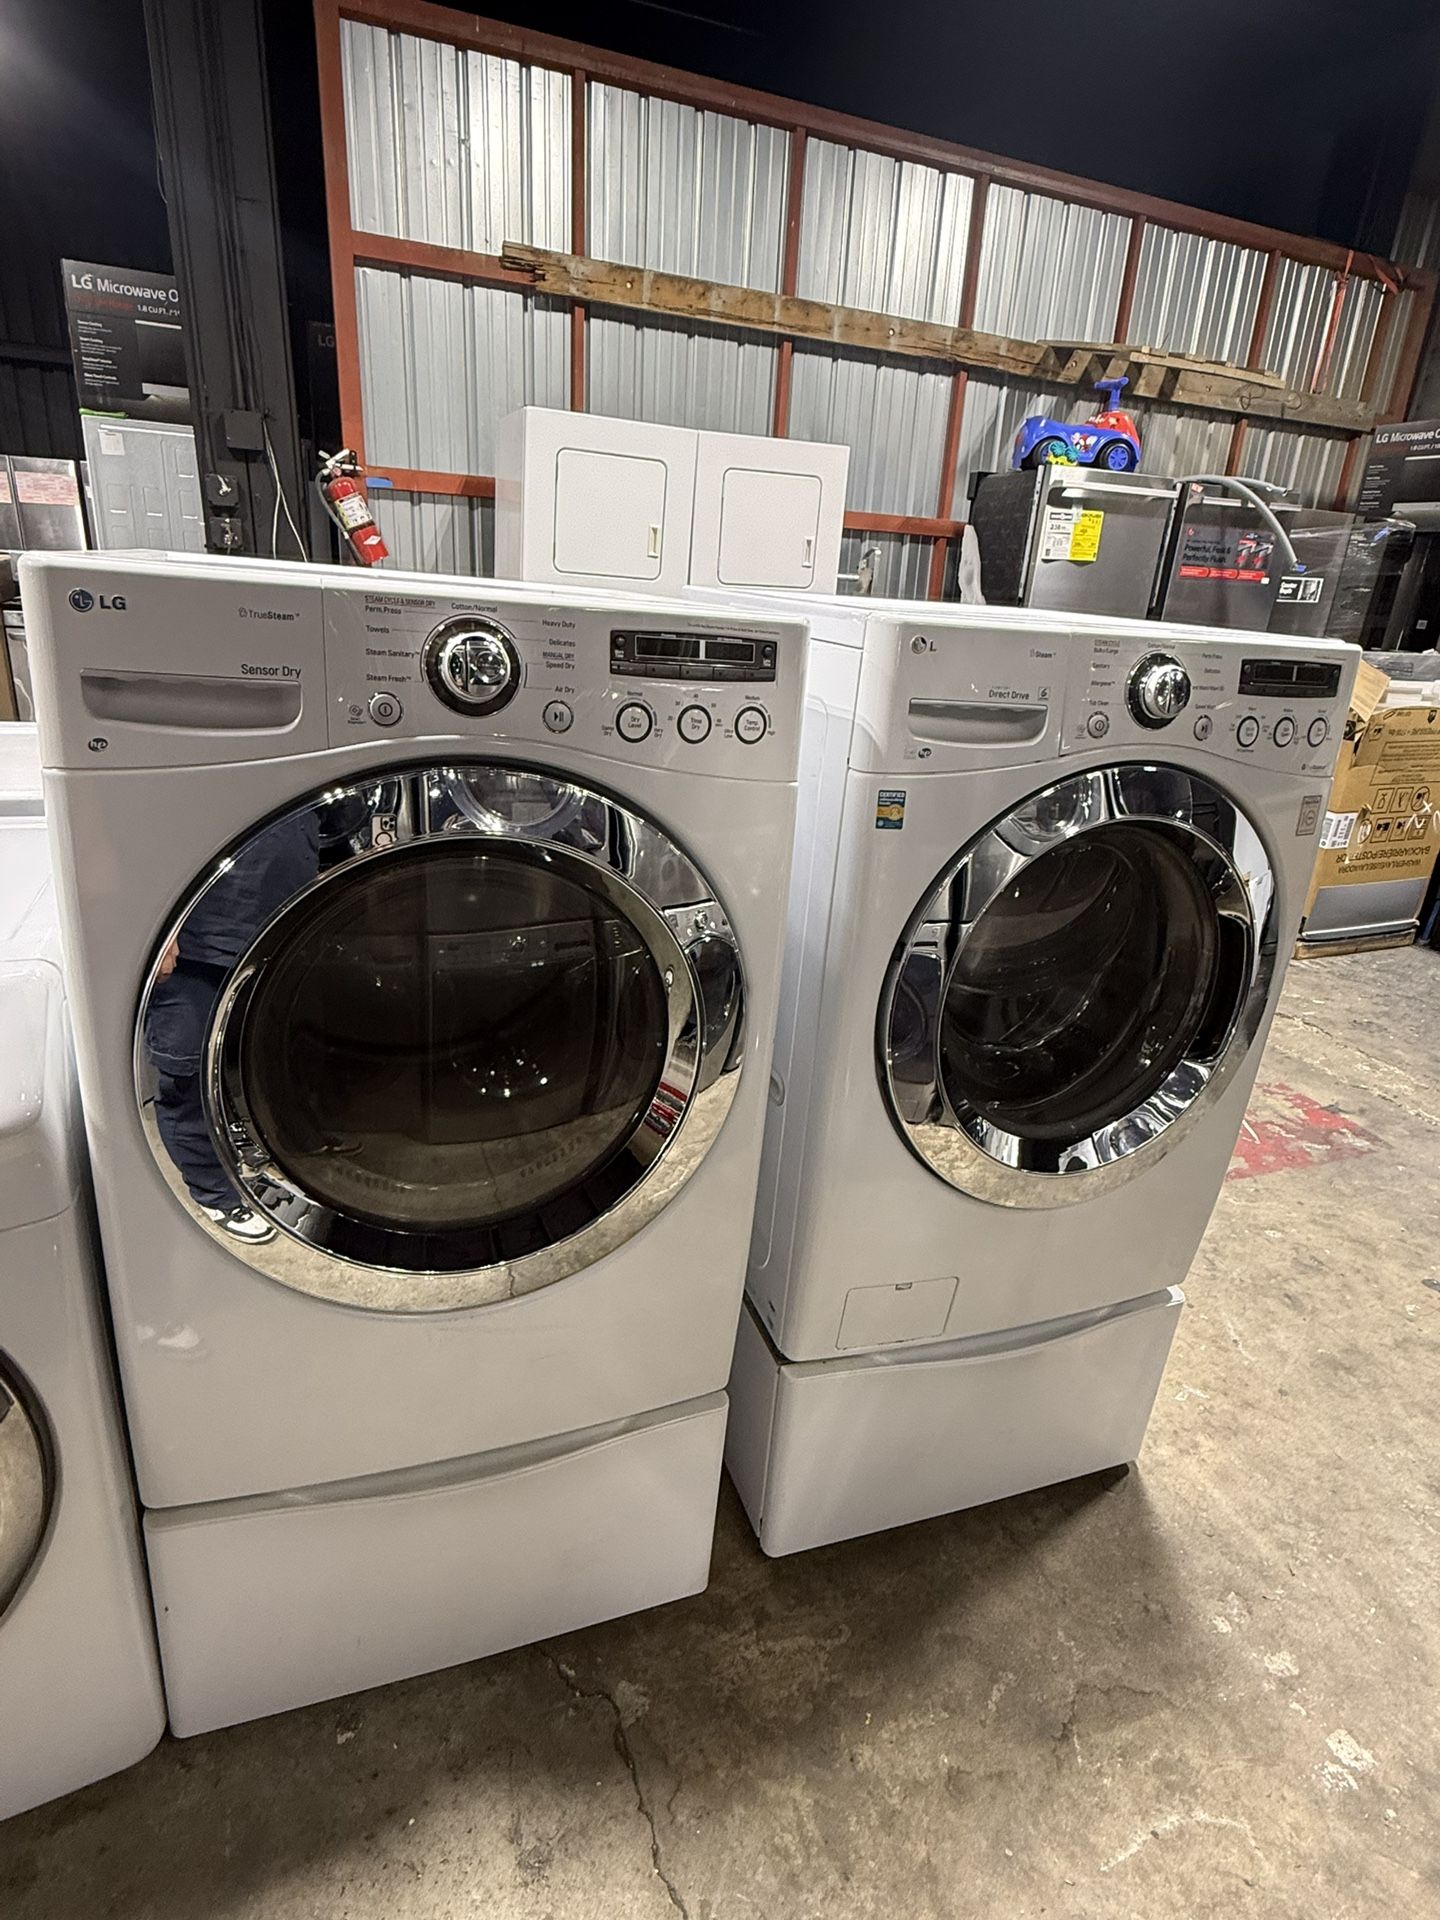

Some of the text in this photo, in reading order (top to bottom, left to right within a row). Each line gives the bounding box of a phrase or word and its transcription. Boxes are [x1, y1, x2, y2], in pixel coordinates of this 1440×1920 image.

[71, 274, 92, 290] LG
[97, 278, 166, 300] Microwave
[1376, 433, 1389, 444] LG
[1390, 431, 1434, 442] Microwave
[100, 595, 126, 611] LG
[451, 603, 497, 613] Cotton/Normal
[366, 625, 390, 633] Towels
[542, 620, 576, 629] Heavy Duty
[549, 638, 576, 647] Delicates
[366, 648, 386, 656] Steam
[545, 662, 575, 671] Speed Dry
[241, 664, 301, 681] Sensor Dry
[366, 674, 386, 682] Steam
[989, 689, 1030, 700] Direct Drive
[630, 715, 640, 724] Dry
